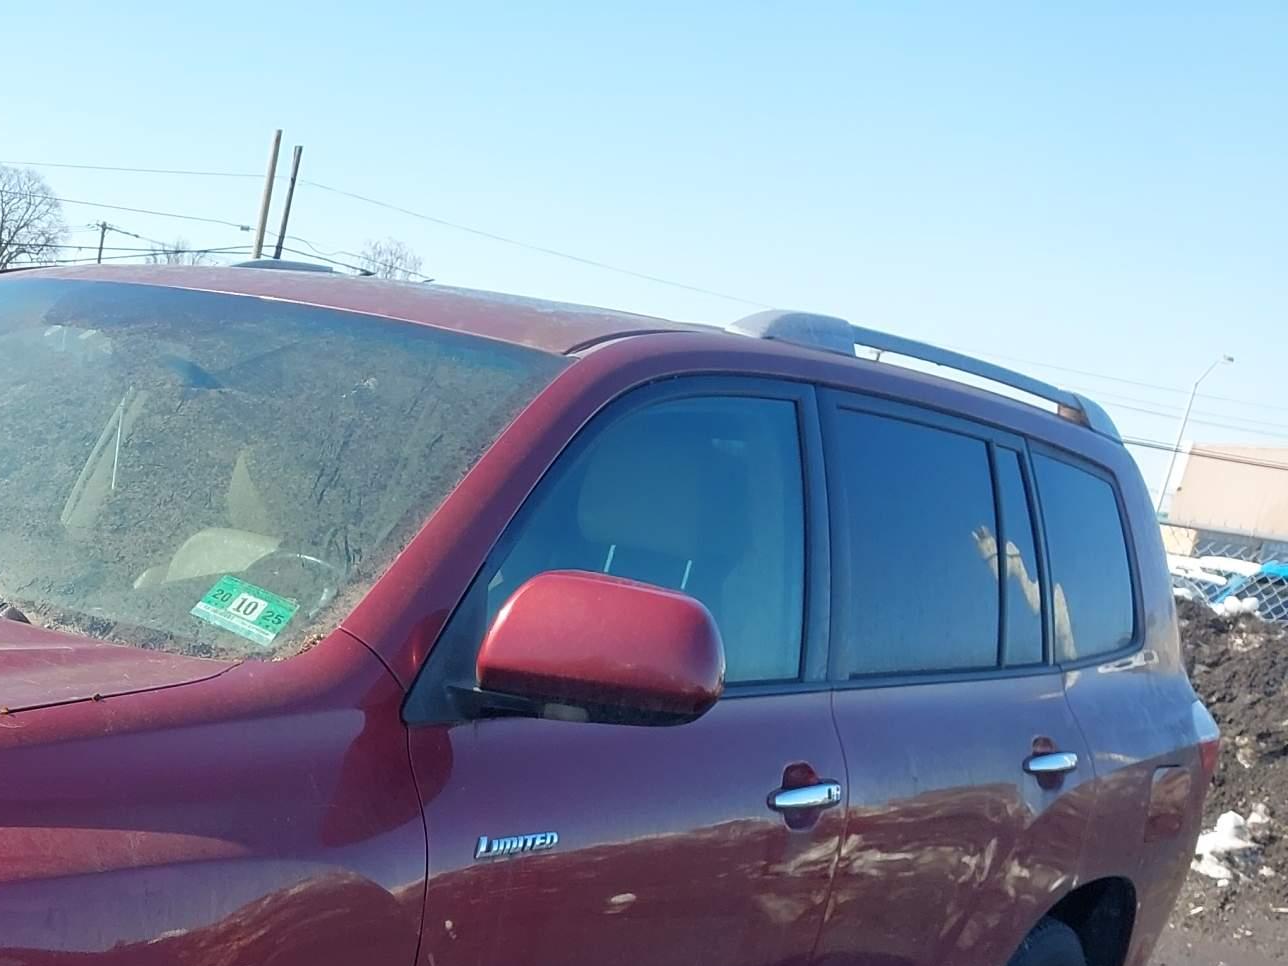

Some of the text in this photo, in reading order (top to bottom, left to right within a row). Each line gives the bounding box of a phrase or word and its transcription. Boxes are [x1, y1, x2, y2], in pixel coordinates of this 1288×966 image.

[211, 588, 233, 602] 20
[232, 597, 258, 616] 10
[261, 610, 285, 625] 25
